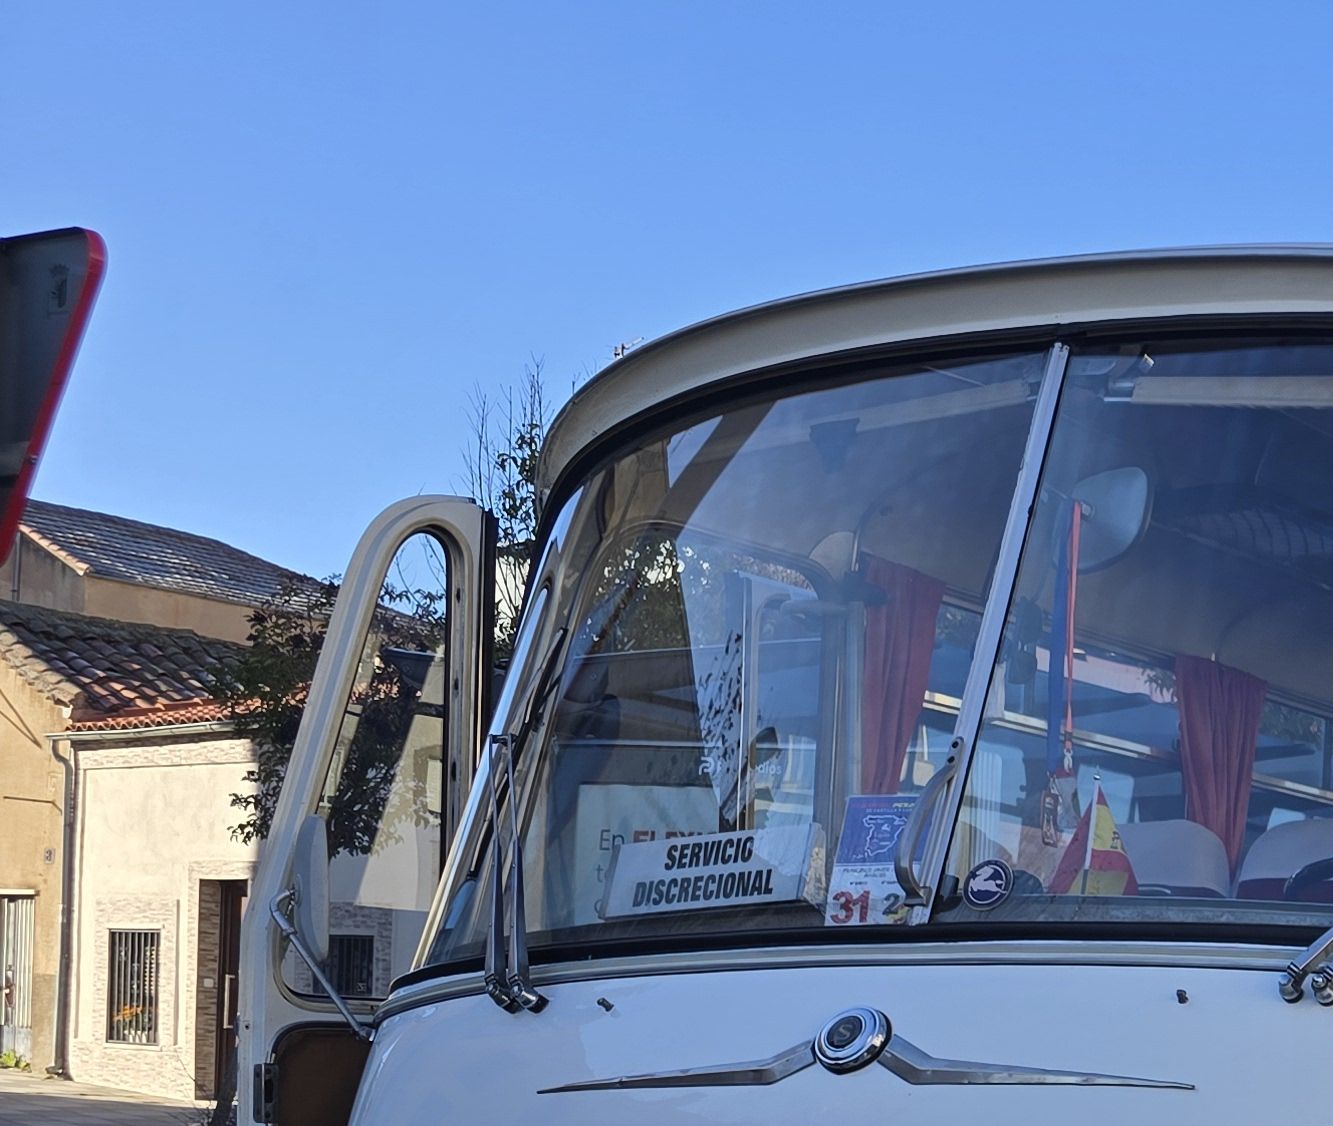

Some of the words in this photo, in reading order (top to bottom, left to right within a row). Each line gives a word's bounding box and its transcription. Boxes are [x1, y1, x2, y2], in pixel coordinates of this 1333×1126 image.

[664, 836, 755, 871] SERVICIO
[632, 869, 774, 908] DISCRECIONAL
[830, 890, 871, 924] 31
